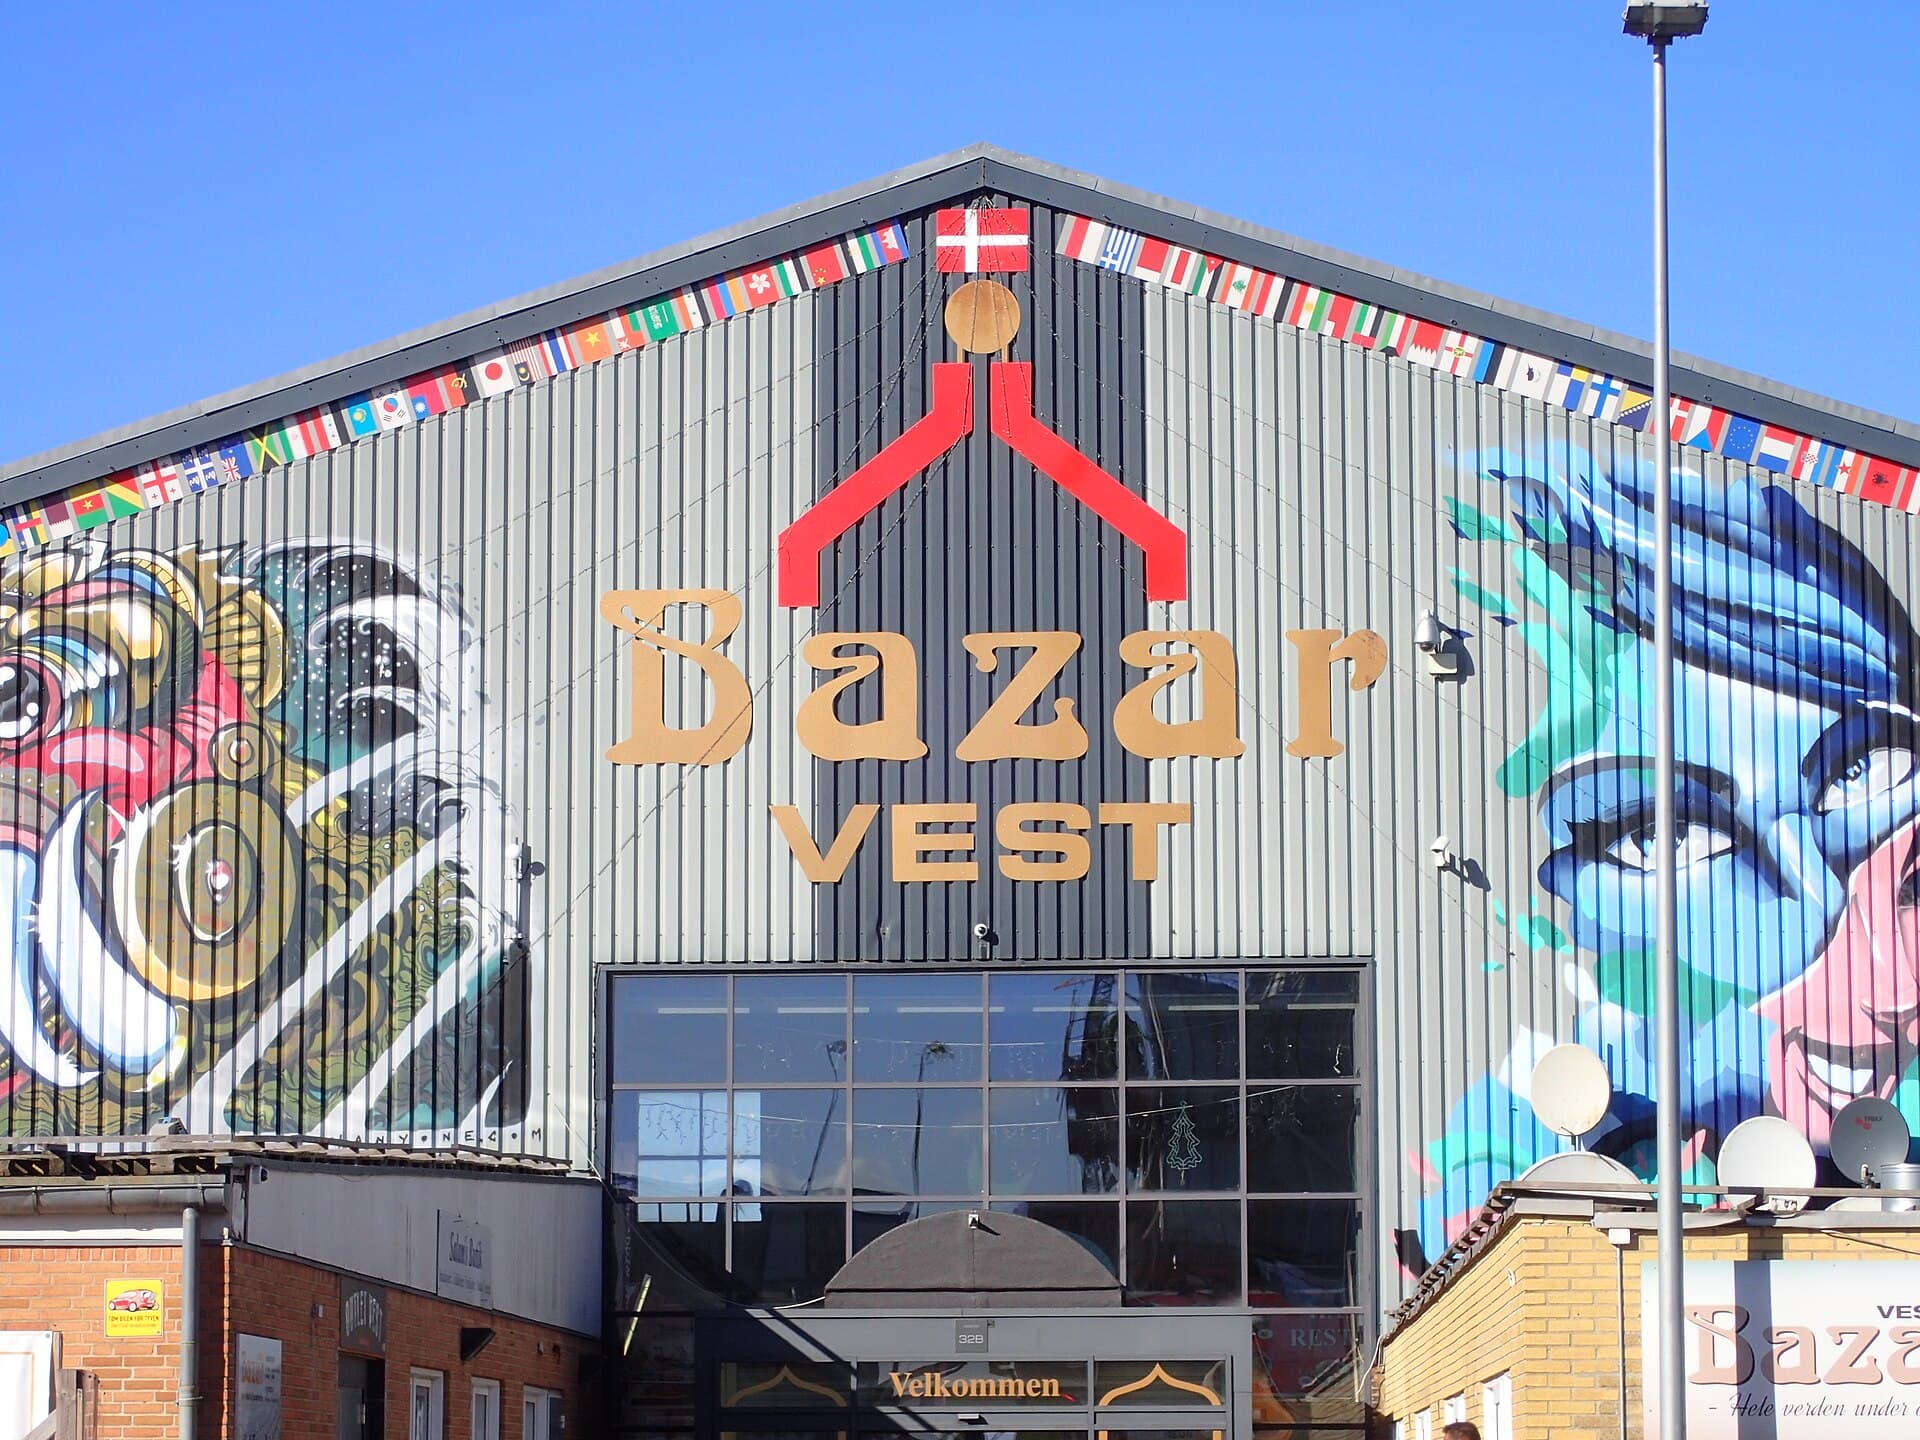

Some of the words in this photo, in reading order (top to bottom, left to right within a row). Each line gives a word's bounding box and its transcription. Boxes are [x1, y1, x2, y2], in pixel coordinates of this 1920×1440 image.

[599, 588, 1387, 766] Bazar
[769, 802, 1192, 883] VEST
[889, 1372, 1061, 1397] Velkommen
[1729, 1392, 1774, 1417] Hele
[1783, 1396, 1846, 1417] verden
[1854, 1396, 1911, 1417] under
